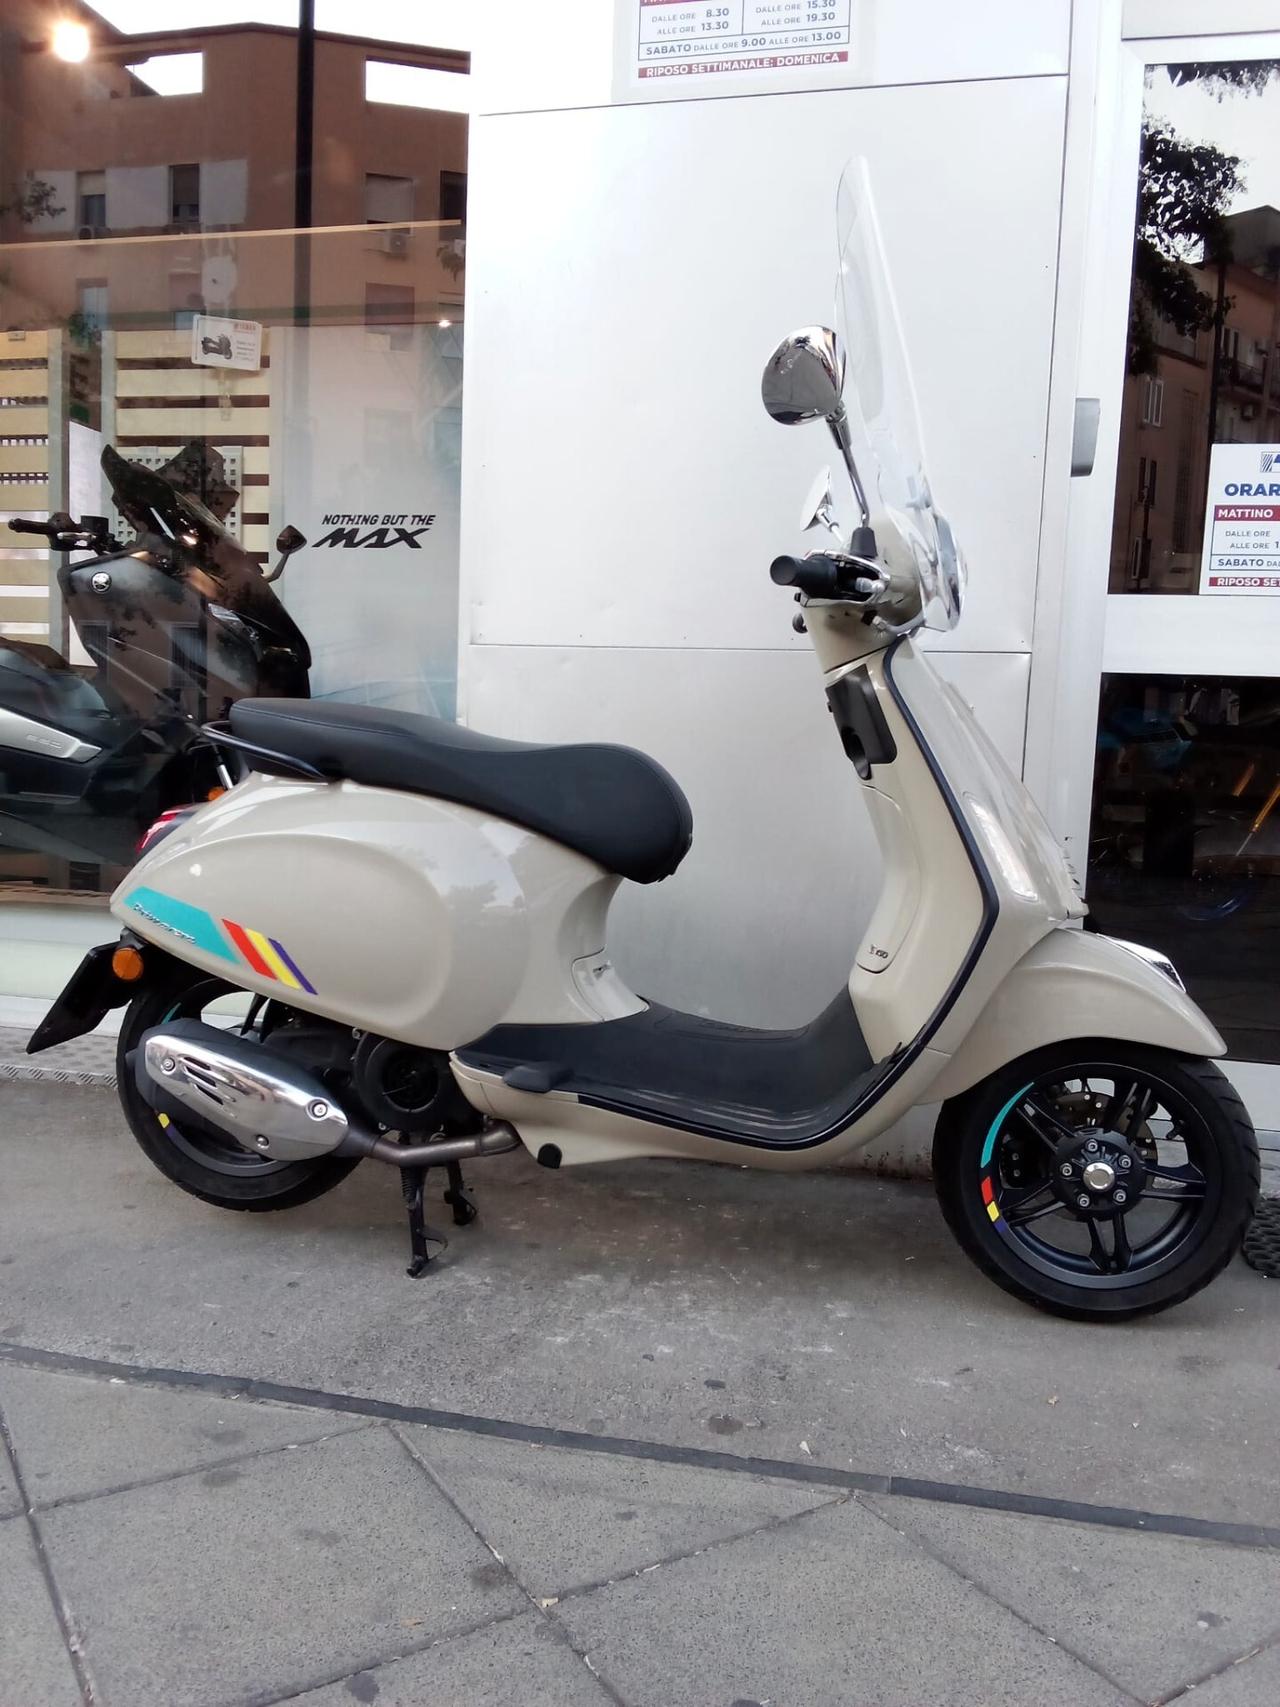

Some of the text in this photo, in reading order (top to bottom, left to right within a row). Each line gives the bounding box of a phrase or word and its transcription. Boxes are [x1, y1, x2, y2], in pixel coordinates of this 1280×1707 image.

[755, 0, 836, 13] DALLE ORE 15.30
[651, 14, 677, 23] DALLE
[706, 8, 730, 18] 8.30
[761, 12, 836, 26] ALLE ORE 19.30
[657, 21, 729, 35] ALLE ORE 13.30
[646, 31, 841, 55] SABATO DALLE ORE 9.00 ALLE ORE 13.00
[646, 53, 840, 77] RIPOSO SETTIMANALE: DOMENICA
[1224, 483, 1280, 496] ORAR
[322, 514, 436, 525] NOTHING BUT THE
[1218, 508, 1274, 518] MATTINO
[311, 528, 430, 549] MAX
[1218, 558, 1264, 567] SABATO
[1217, 577, 1260, 586] RIPOSO
